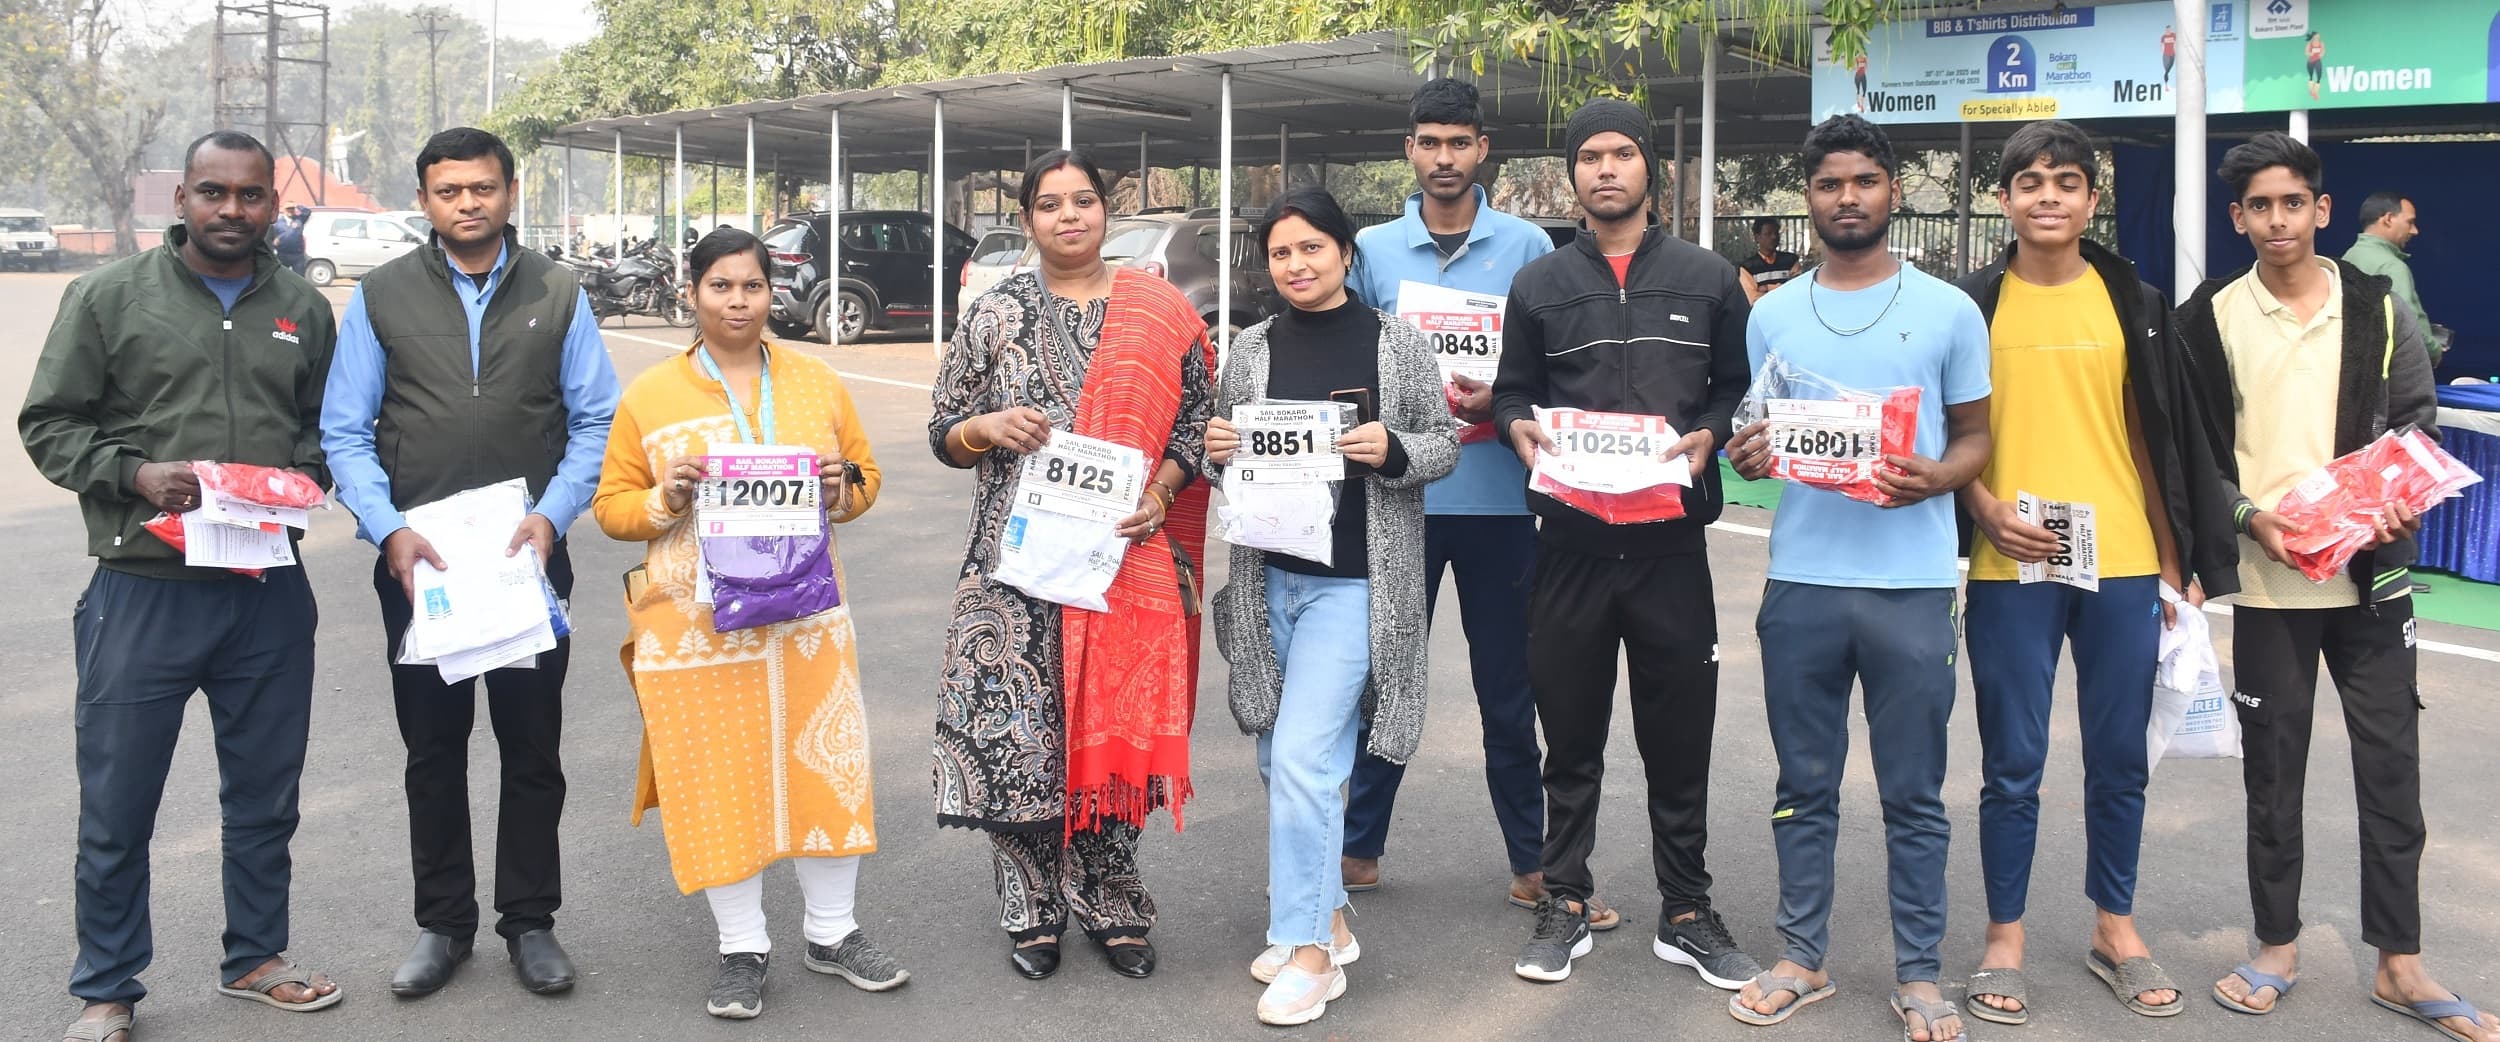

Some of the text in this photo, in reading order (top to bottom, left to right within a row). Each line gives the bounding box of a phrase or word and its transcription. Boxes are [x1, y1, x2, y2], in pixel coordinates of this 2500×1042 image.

[1933, 12, 2078, 34] BIB & T'shirts Distribution
[2006, 43, 2021, 66] 2
[1998, 72, 2028, 88] Km
[2046, 71, 2092, 80] Marathon
[2326, 65, 2432, 93] Women
[1868, 91, 1936, 113] Women
[2113, 80, 2162, 103] Men
[1980, 103, 2023, 115] Specially
[2027, 101, 2056, 112] Abled
[272, 331, 299, 345] adidas
[1431, 332, 1489, 356] 0843
[1057, 443, 1077, 452] HALF
[1065, 439, 1081, 448] SAIL
[1251, 430, 1314, 455] 8851
[1567, 431, 1651, 456] 10254
[1785, 428, 1863, 458] 10897
[1046, 457, 1115, 494] 8125
[1123, 473, 1134, 501] FEMALE
[717, 479, 804, 506] 12007
